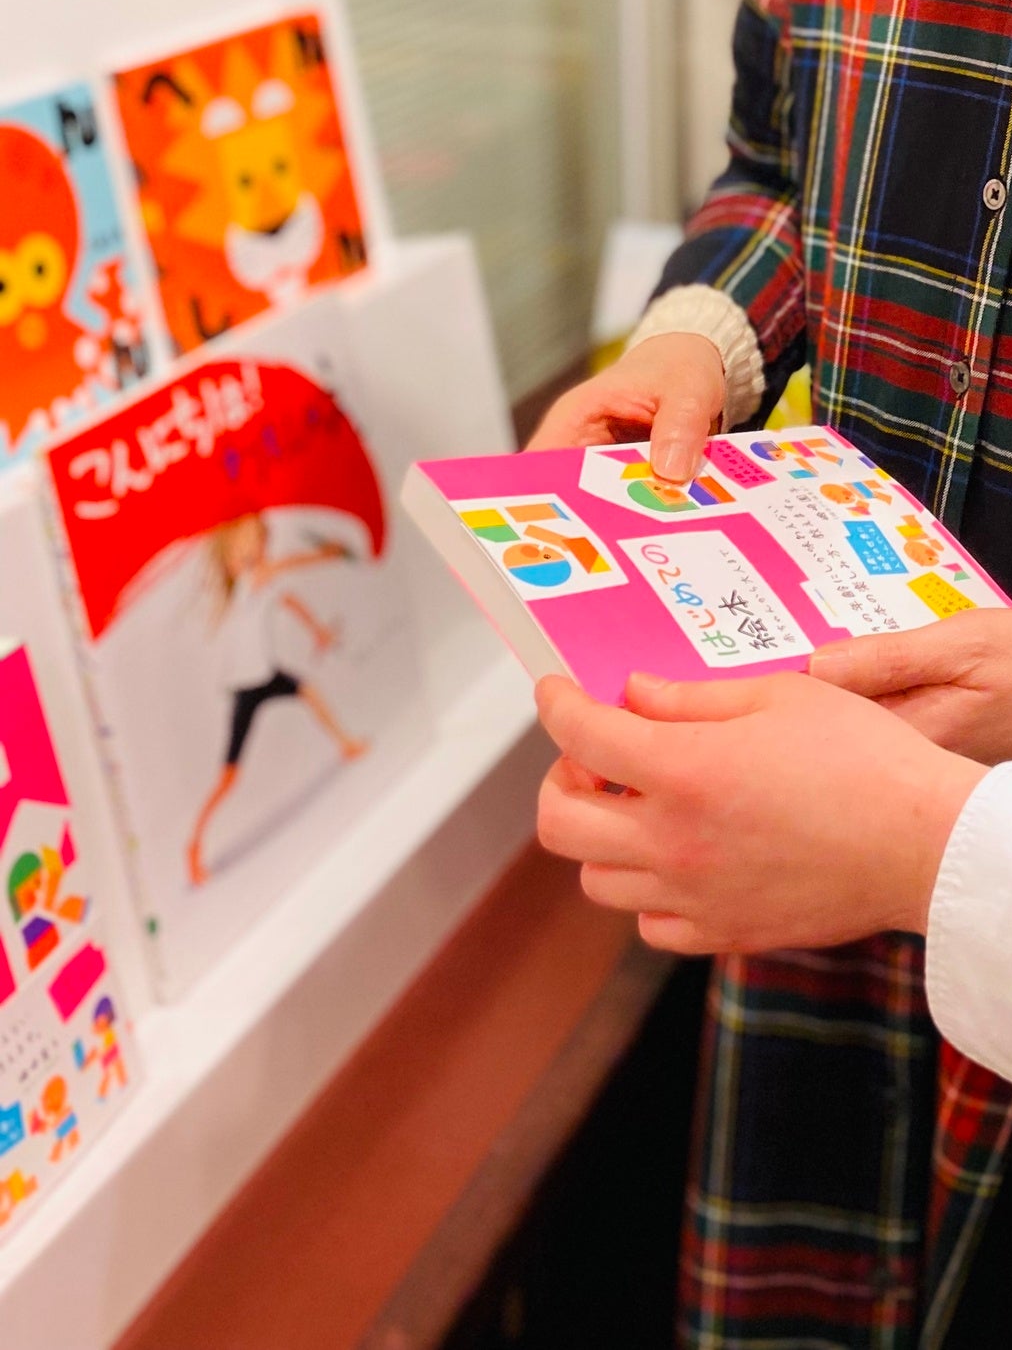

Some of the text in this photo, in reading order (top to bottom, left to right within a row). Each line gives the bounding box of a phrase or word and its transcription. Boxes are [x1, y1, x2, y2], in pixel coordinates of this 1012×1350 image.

[640, 543, 741, 657] はじめての
[717, 588, 779, 650] 絵本
